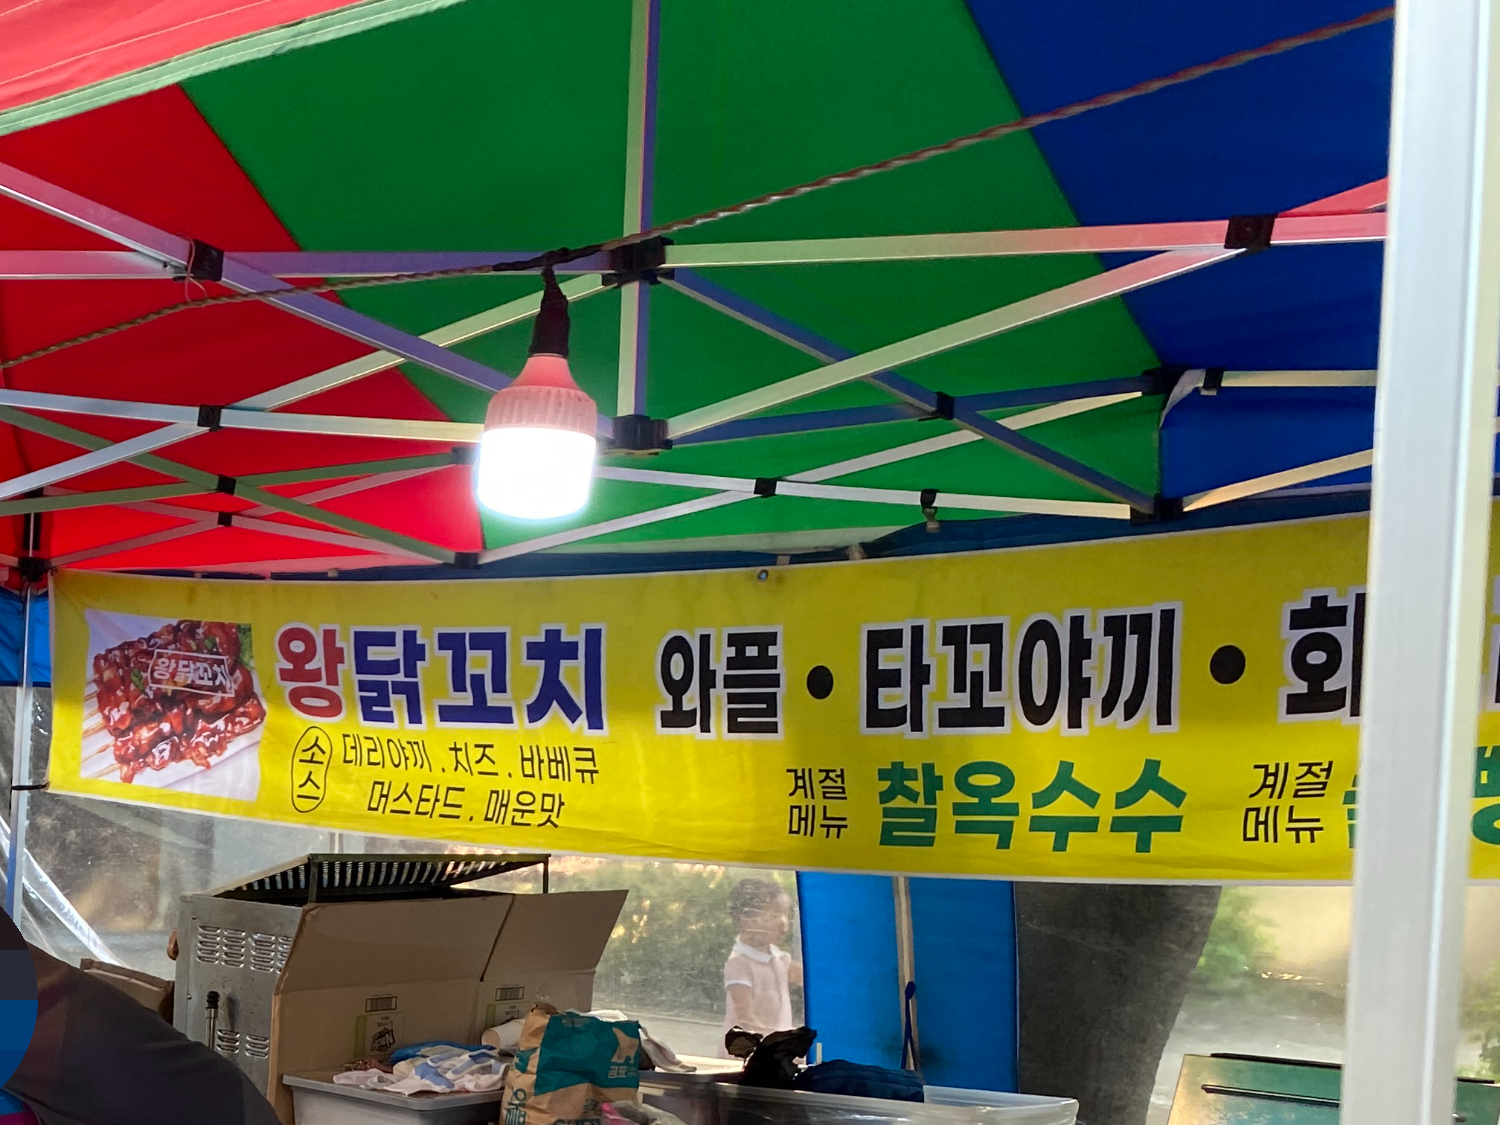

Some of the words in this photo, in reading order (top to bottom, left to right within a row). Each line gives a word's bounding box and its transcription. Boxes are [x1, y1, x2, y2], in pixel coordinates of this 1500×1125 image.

[276, 627, 605, 730] 왕닭꼬치
[660, 631, 782, 734] 와플
[865, 608, 1177, 732] 타꼬야끼
[519, 744, 599, 784] 바베큐
[1248, 761, 1334, 800] 계절
[786, 767, 848, 801] 계절
[483, 788, 565, 829] 매운맛
[788, 805, 848, 839] 메뉴
[877, 758, 1188, 853] 찰옥수수
[1242, 806, 1324, 844] 메뉴
